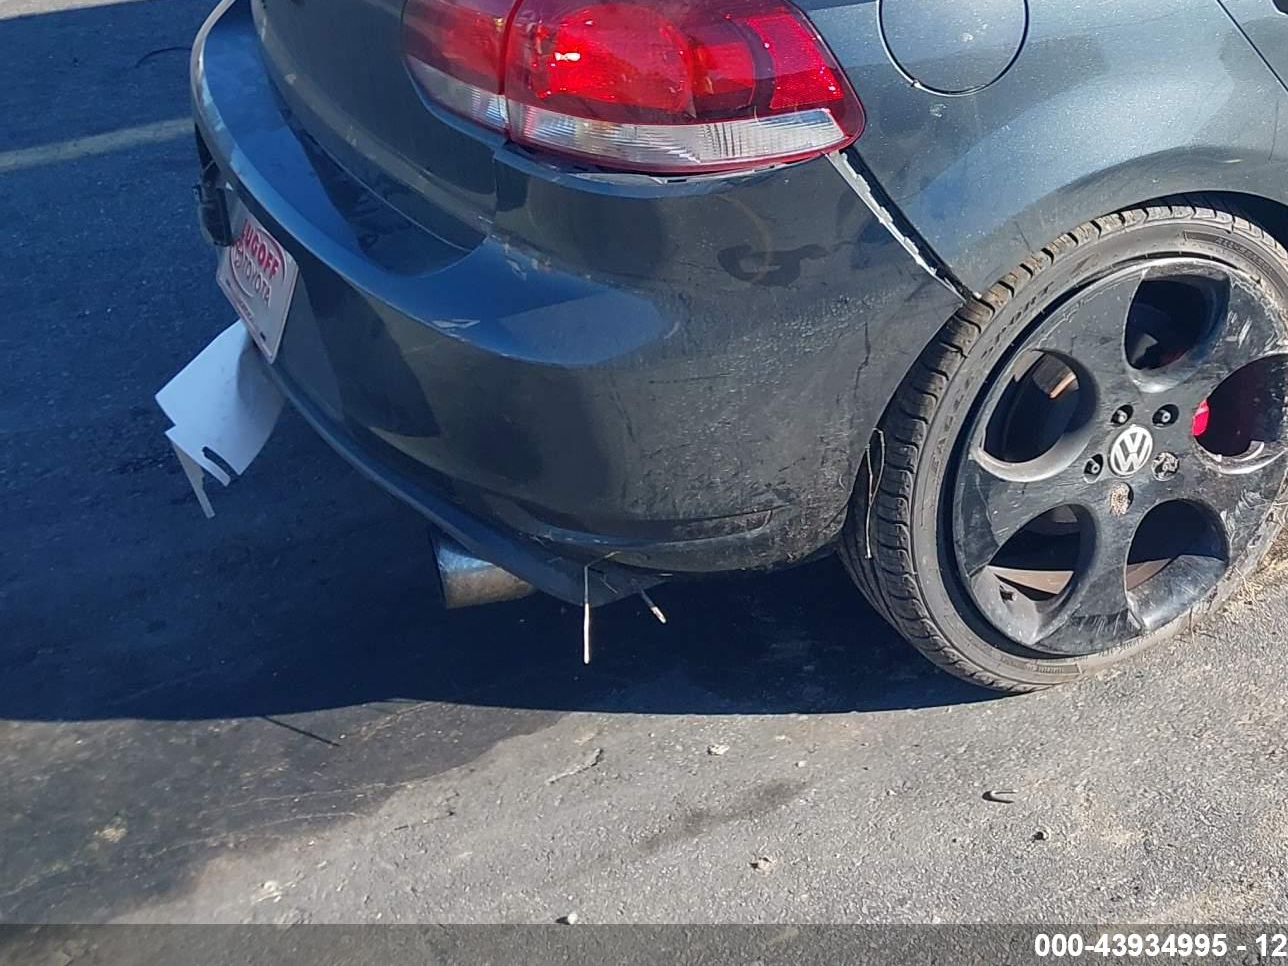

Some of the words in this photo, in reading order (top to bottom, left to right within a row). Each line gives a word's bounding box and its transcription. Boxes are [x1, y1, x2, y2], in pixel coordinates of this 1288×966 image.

[241, 219, 281, 280] LUGOFF
[242, 253, 273, 308] TOYOTA
[1110, 425, 1153, 476] VW
